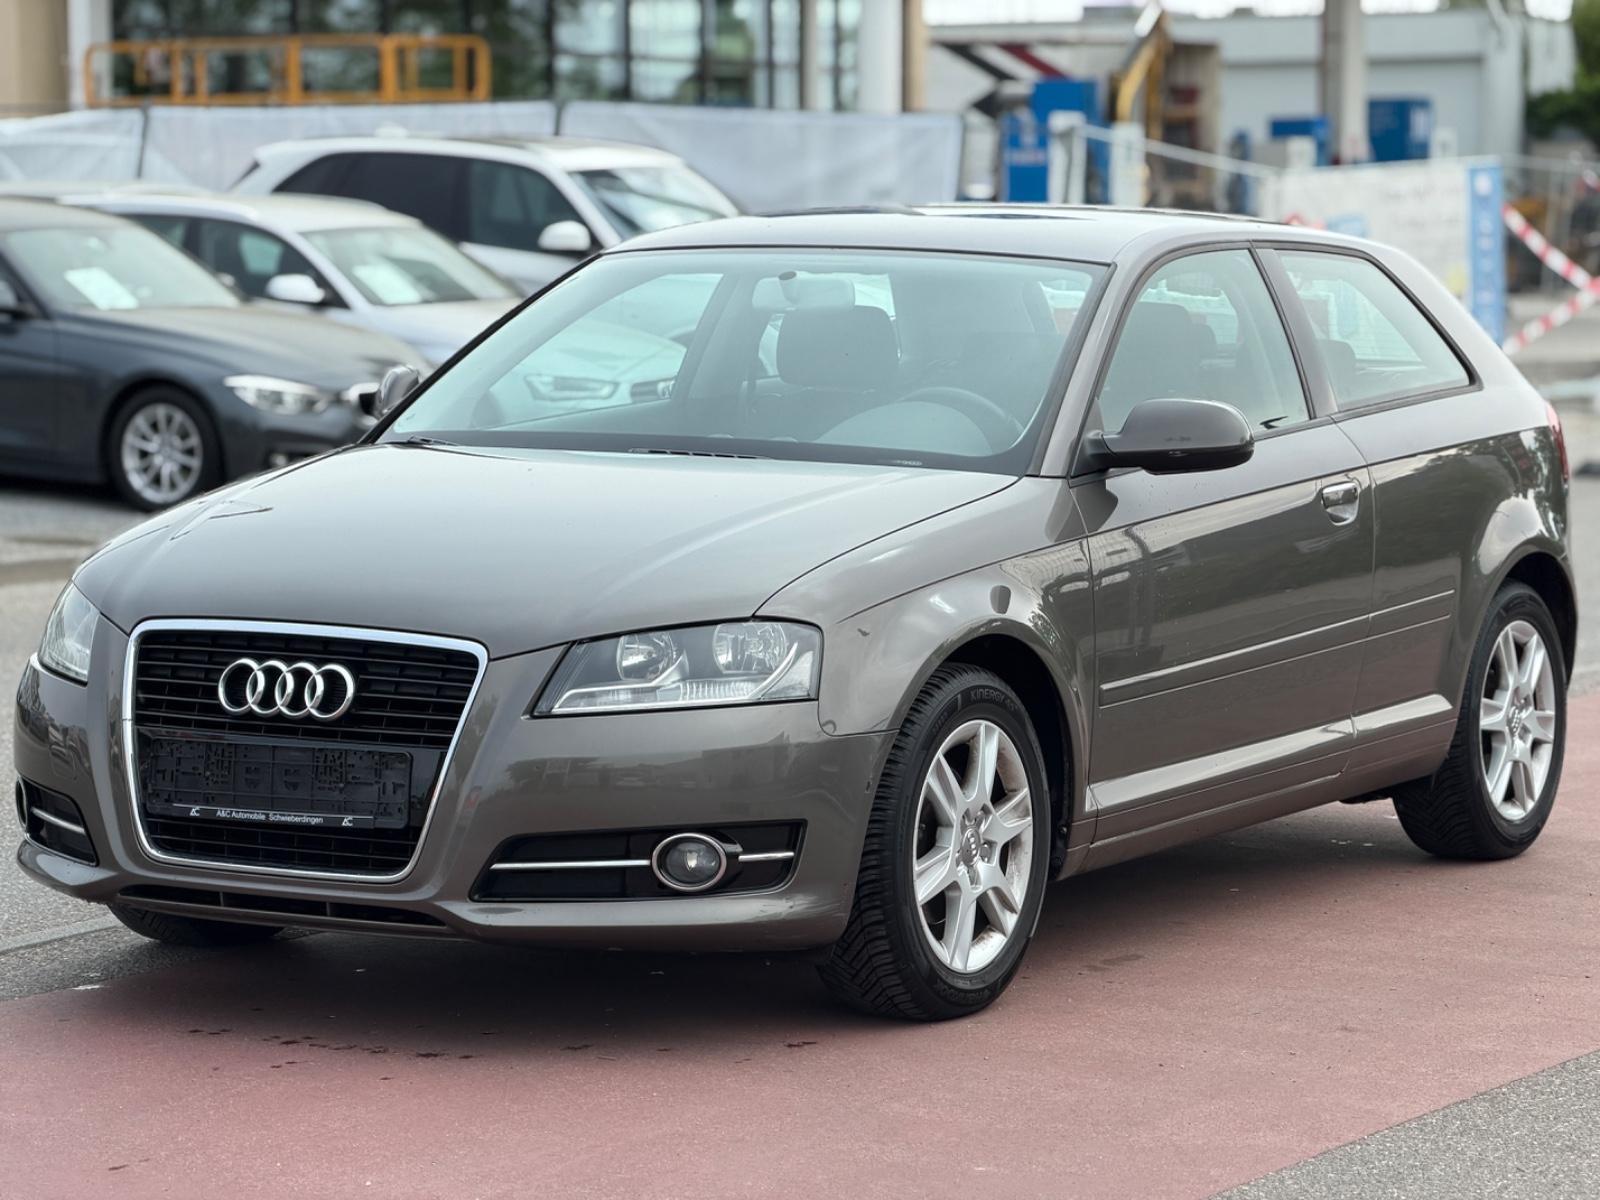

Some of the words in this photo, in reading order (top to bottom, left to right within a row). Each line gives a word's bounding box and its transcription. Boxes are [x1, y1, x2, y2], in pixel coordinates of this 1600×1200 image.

[970, 688, 1005, 702] KINERGY
[216, 809, 230, 817] A&C
[232, 811, 266, 820] Automobile
[269, 812, 323, 824] Schwieberdingen
